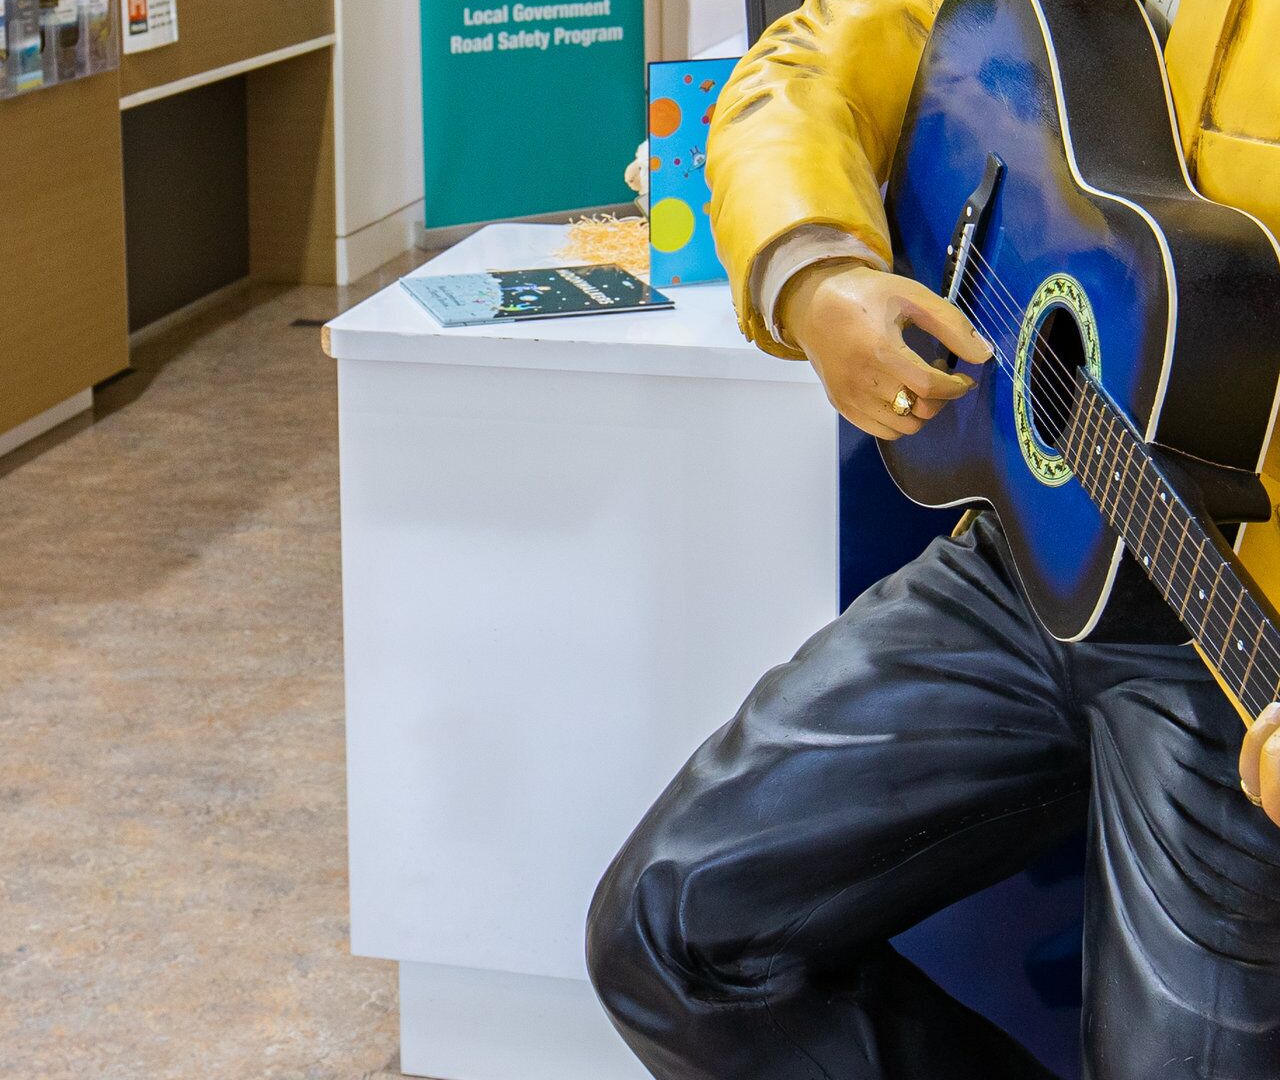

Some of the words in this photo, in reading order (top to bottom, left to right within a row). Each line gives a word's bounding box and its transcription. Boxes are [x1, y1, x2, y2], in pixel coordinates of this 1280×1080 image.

[463, 4, 509, 26] Local
[450, 33, 494, 55] Road
[497, 29, 551, 51] Safety
[553, 26, 624, 48] Program
